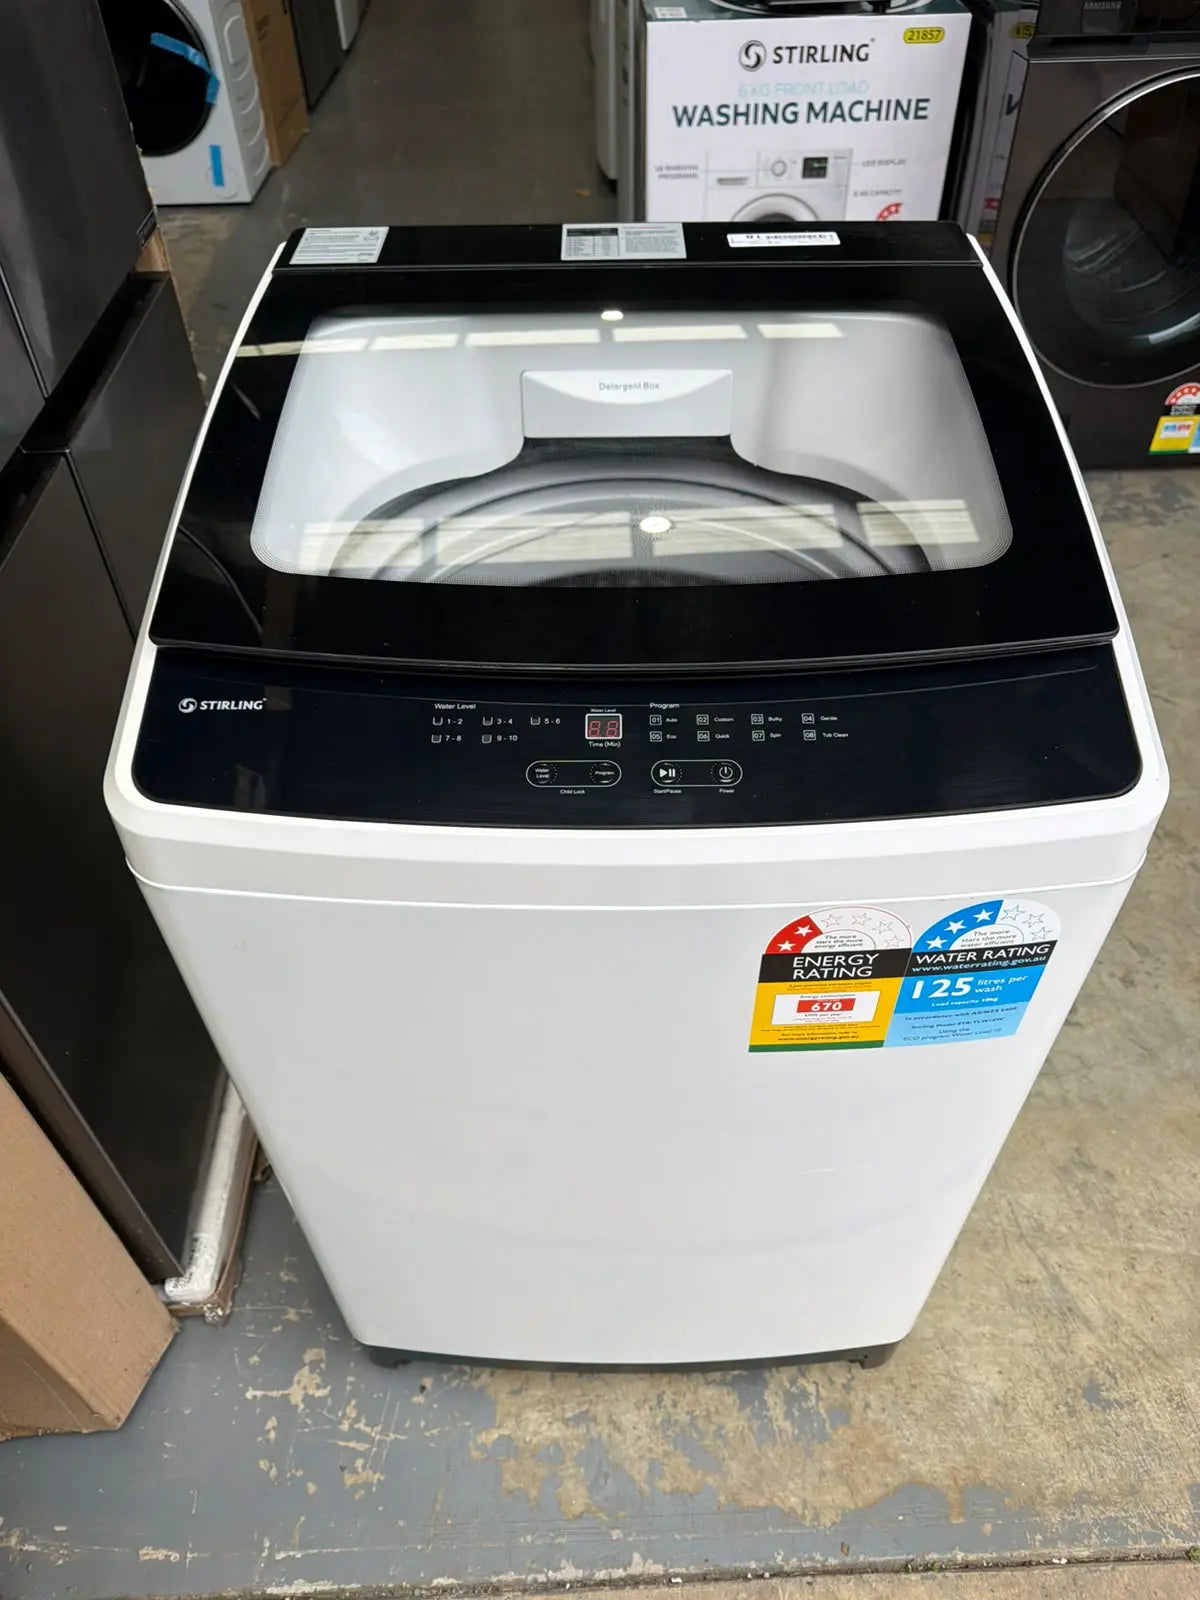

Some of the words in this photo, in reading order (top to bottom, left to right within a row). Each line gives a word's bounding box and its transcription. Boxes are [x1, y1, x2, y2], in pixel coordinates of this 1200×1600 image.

[907, 29, 941, 41] 21857
[772, 44, 869, 64] STIRLING
[751, 83, 770, 97] KG
[773, 82, 825, 96] FRONT
[828, 80, 869, 95] LOAD
[673, 102, 799, 127] WASHING
[806, 98, 930, 123] MACHINE
[599, 382, 641, 392] Detergent
[643, 382, 660, 391] Box
[199, 700, 263, 710] STIRLING
[793, 953, 879, 968] ENERGY
[916, 951, 977, 964] WATER
[982, 944, 1051, 959] RATING
[911, 956, 1047, 972] www.waterrating.gov.au
[793, 966, 873, 980] RATING
[911, 977, 974, 999] 125
[977, 977, 1005, 985] litres
[1008, 975, 1029, 984] per
[811, 1002, 842, 1011] 670
